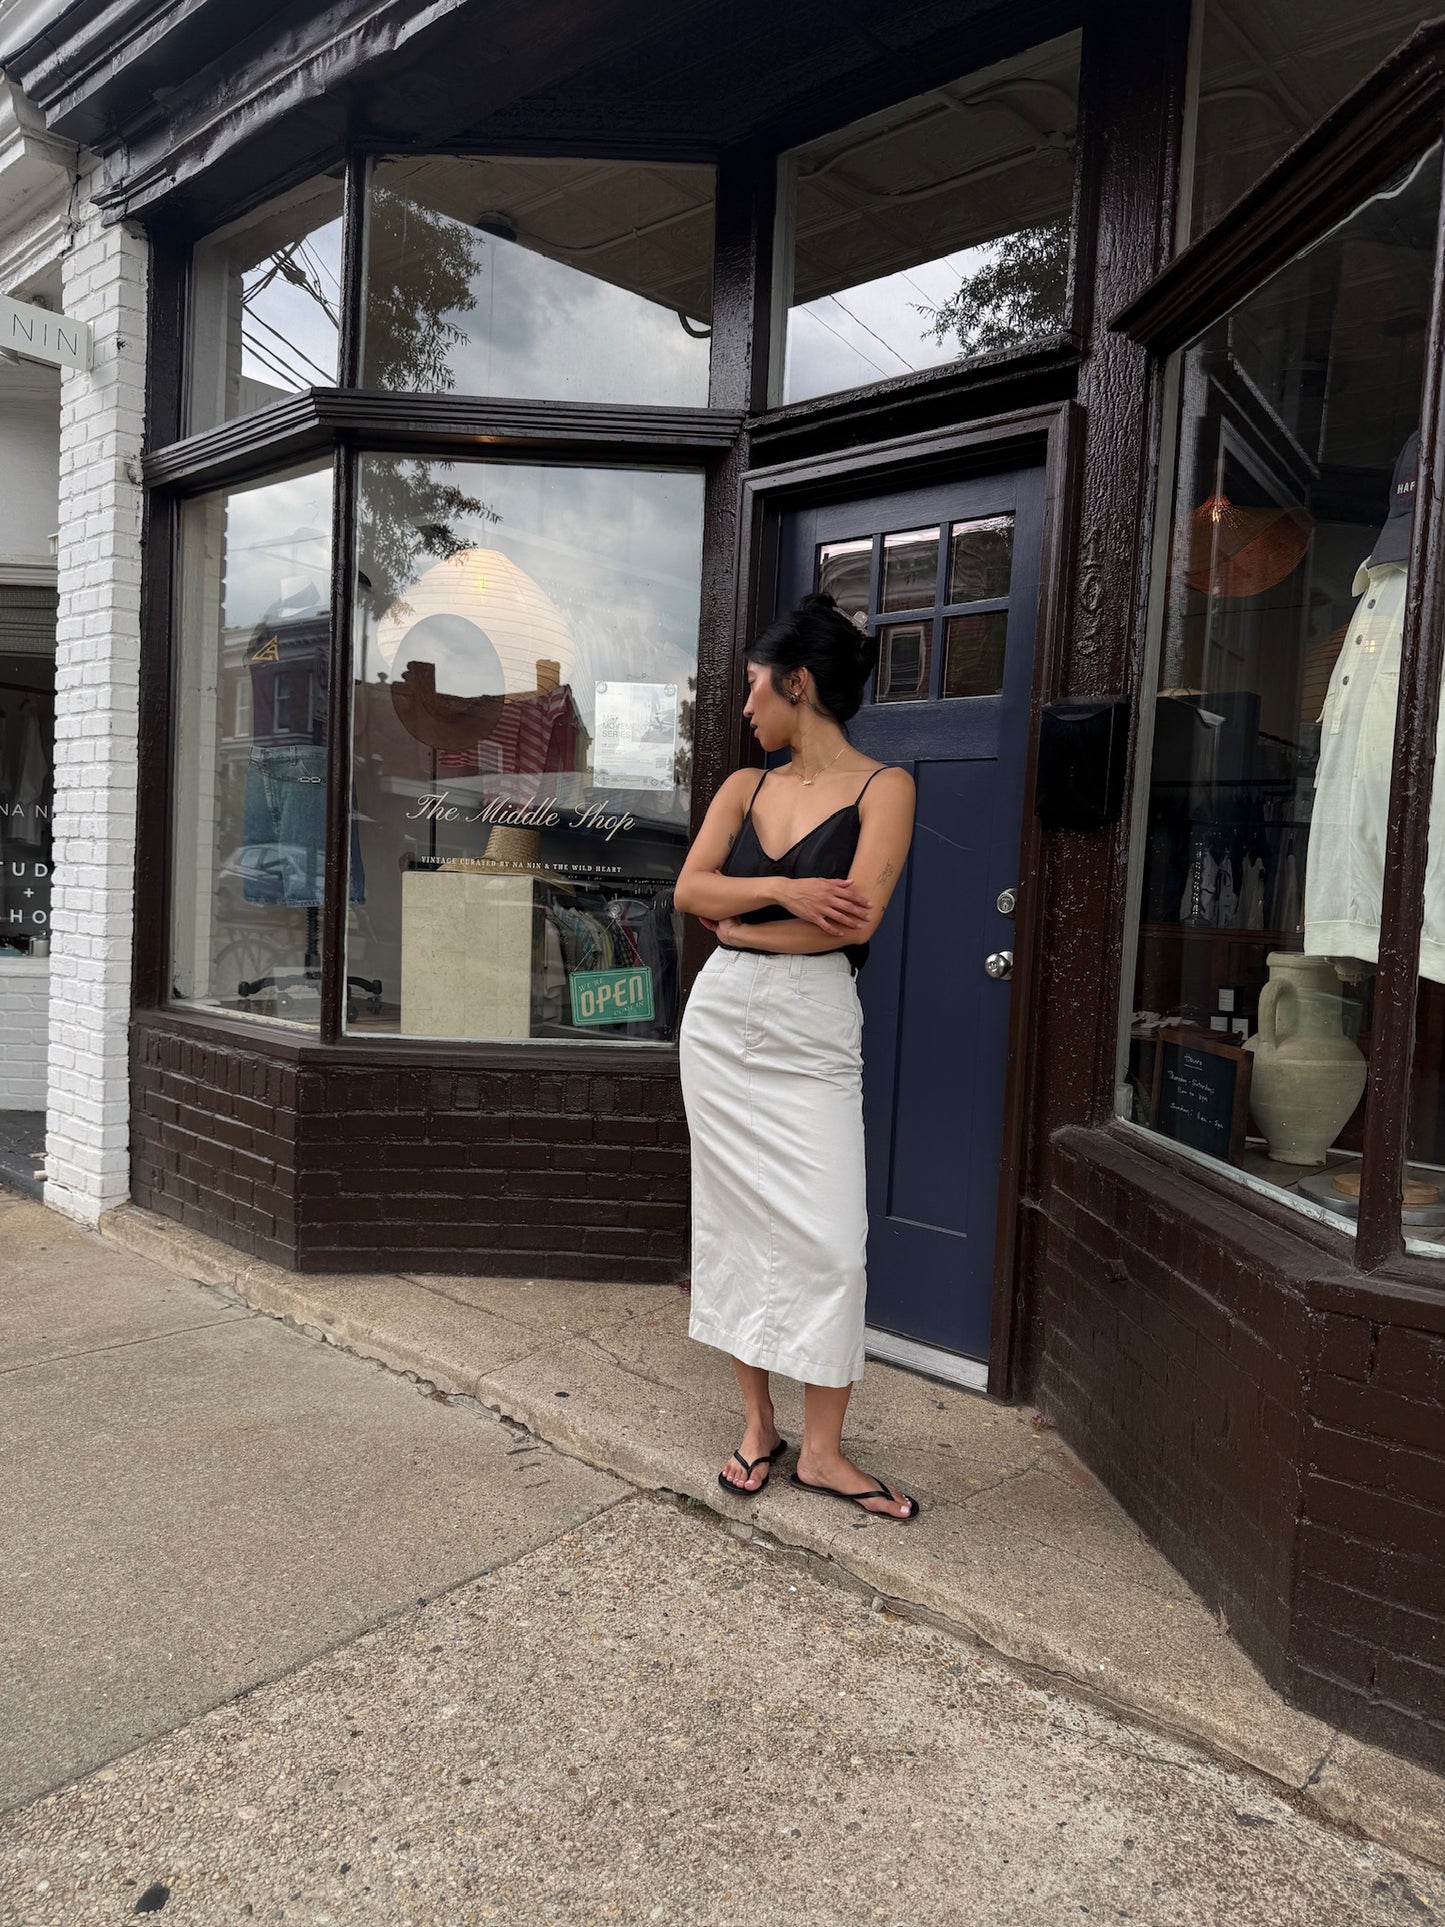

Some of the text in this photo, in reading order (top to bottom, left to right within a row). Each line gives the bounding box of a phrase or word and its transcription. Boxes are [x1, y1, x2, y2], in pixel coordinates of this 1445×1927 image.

[13, 313, 77, 355] NIN
[406, 792, 636, 841] The Middle Shop
[0, 862, 48, 877] UD
[421, 856, 457, 865] VINTAGE
[460, 858, 496, 867] CURATED
[580, 975, 644, 1017] OPEN
